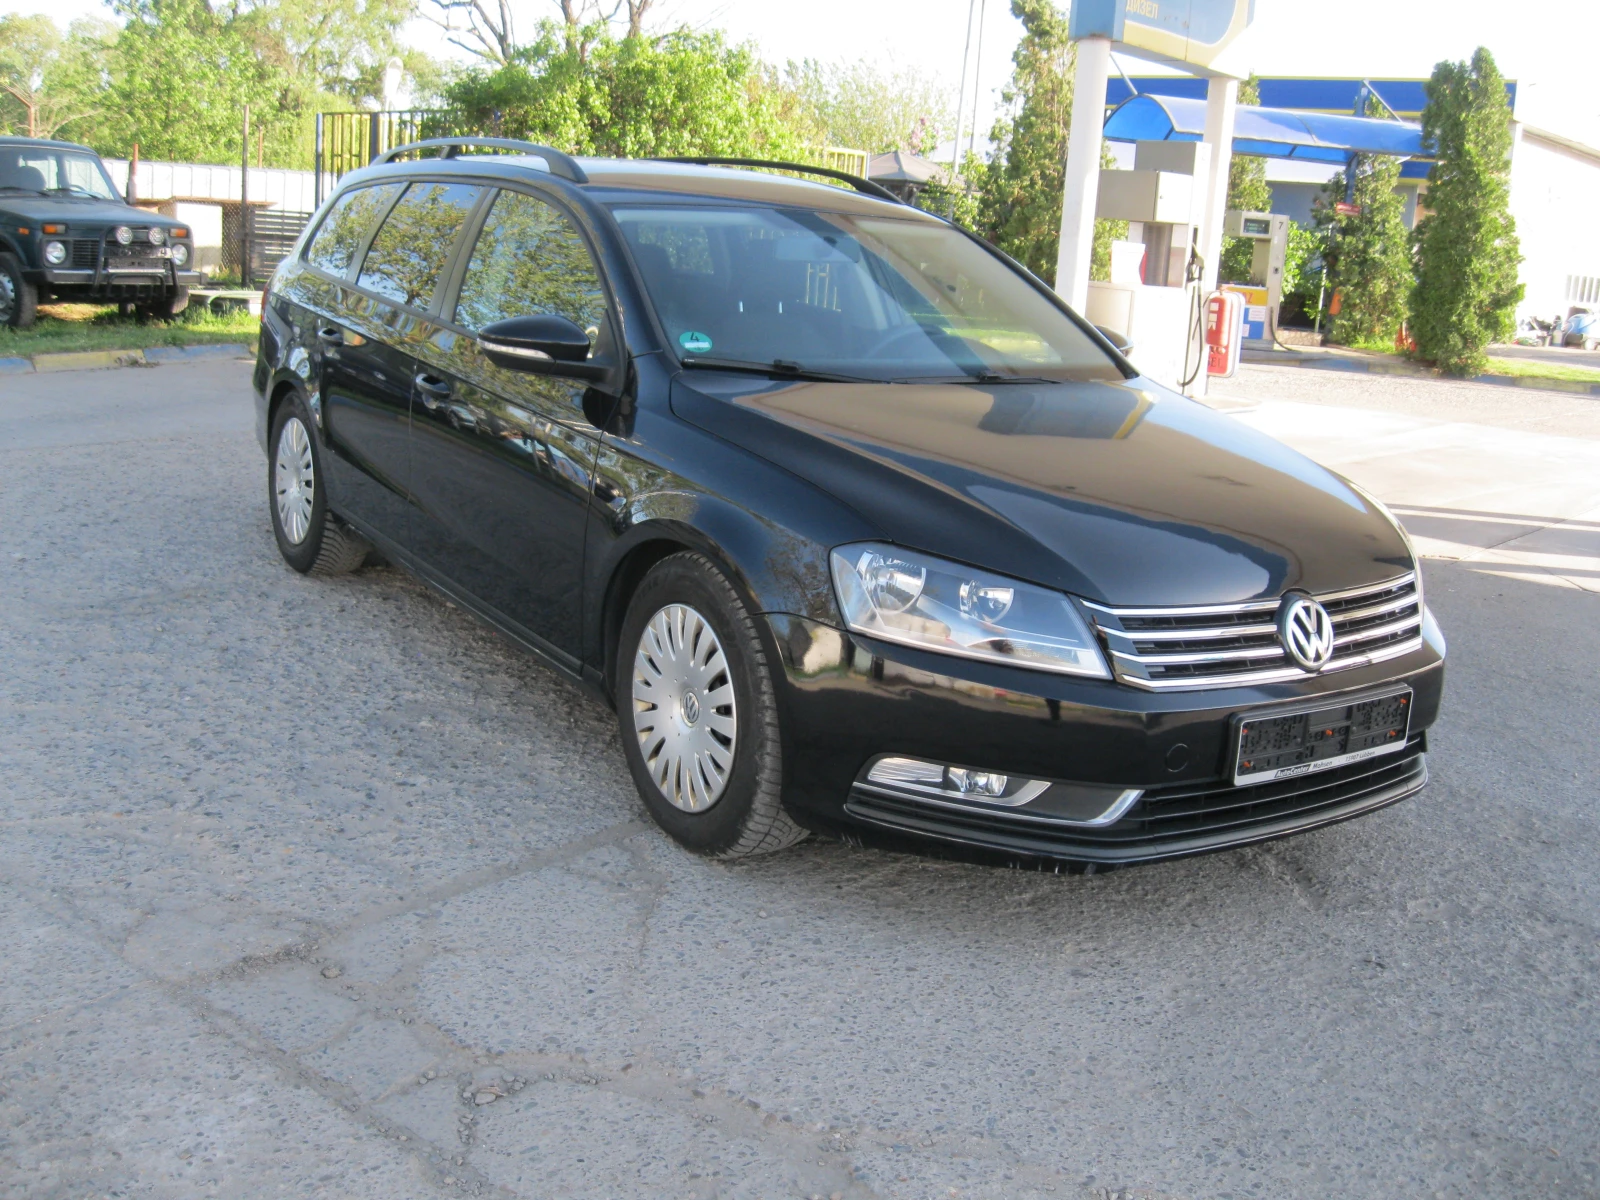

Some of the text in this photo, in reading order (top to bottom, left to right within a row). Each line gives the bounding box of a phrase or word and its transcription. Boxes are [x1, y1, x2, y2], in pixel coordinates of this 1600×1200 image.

[1126, 0, 1159, 19] ДИЗЕЛ
[1278, 221, 1285, 230] 7
[690, 331, 699, 342] 4
